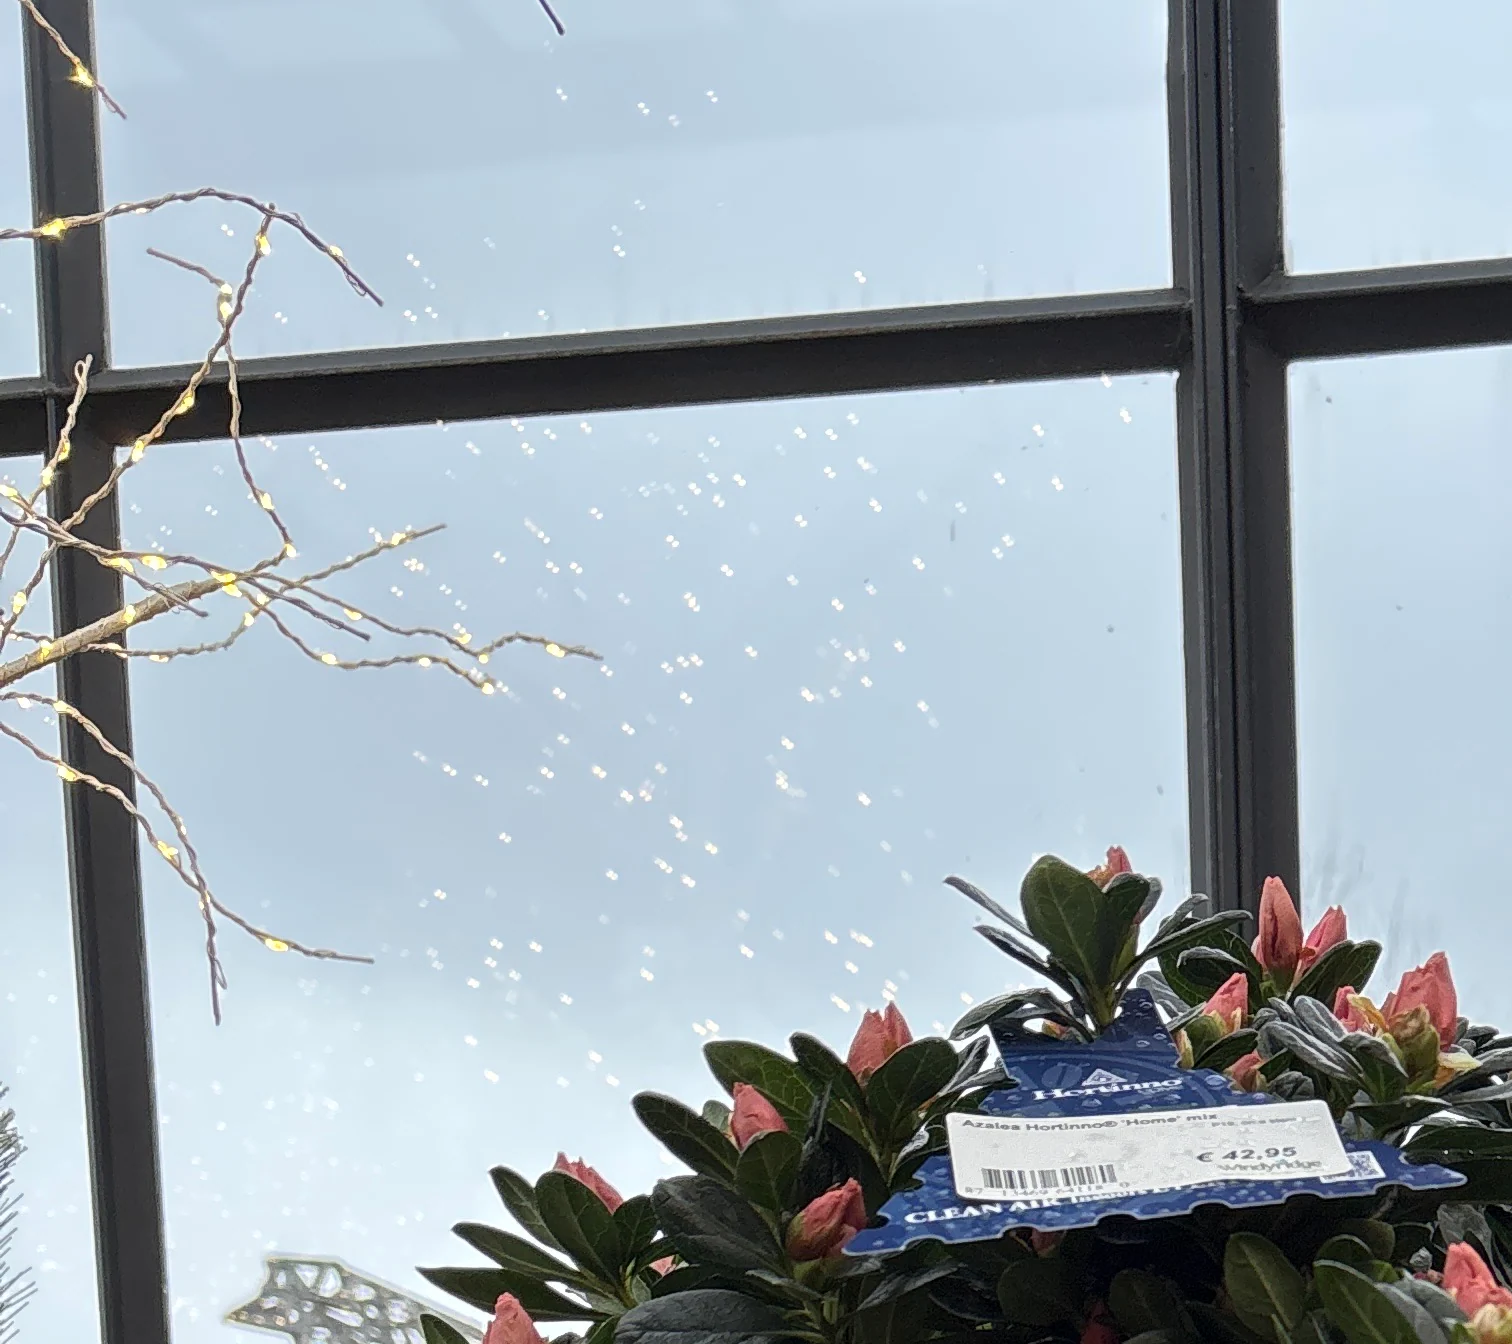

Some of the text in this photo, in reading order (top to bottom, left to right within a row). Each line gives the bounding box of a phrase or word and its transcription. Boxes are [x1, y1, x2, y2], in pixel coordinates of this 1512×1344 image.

[961, 1117, 1021, 1132] Azalea
[1186, 1112, 1218, 1122] mix
[1196, 1146, 1298, 1163] € 42.95
[904, 1202, 1003, 1223] CLEAN
